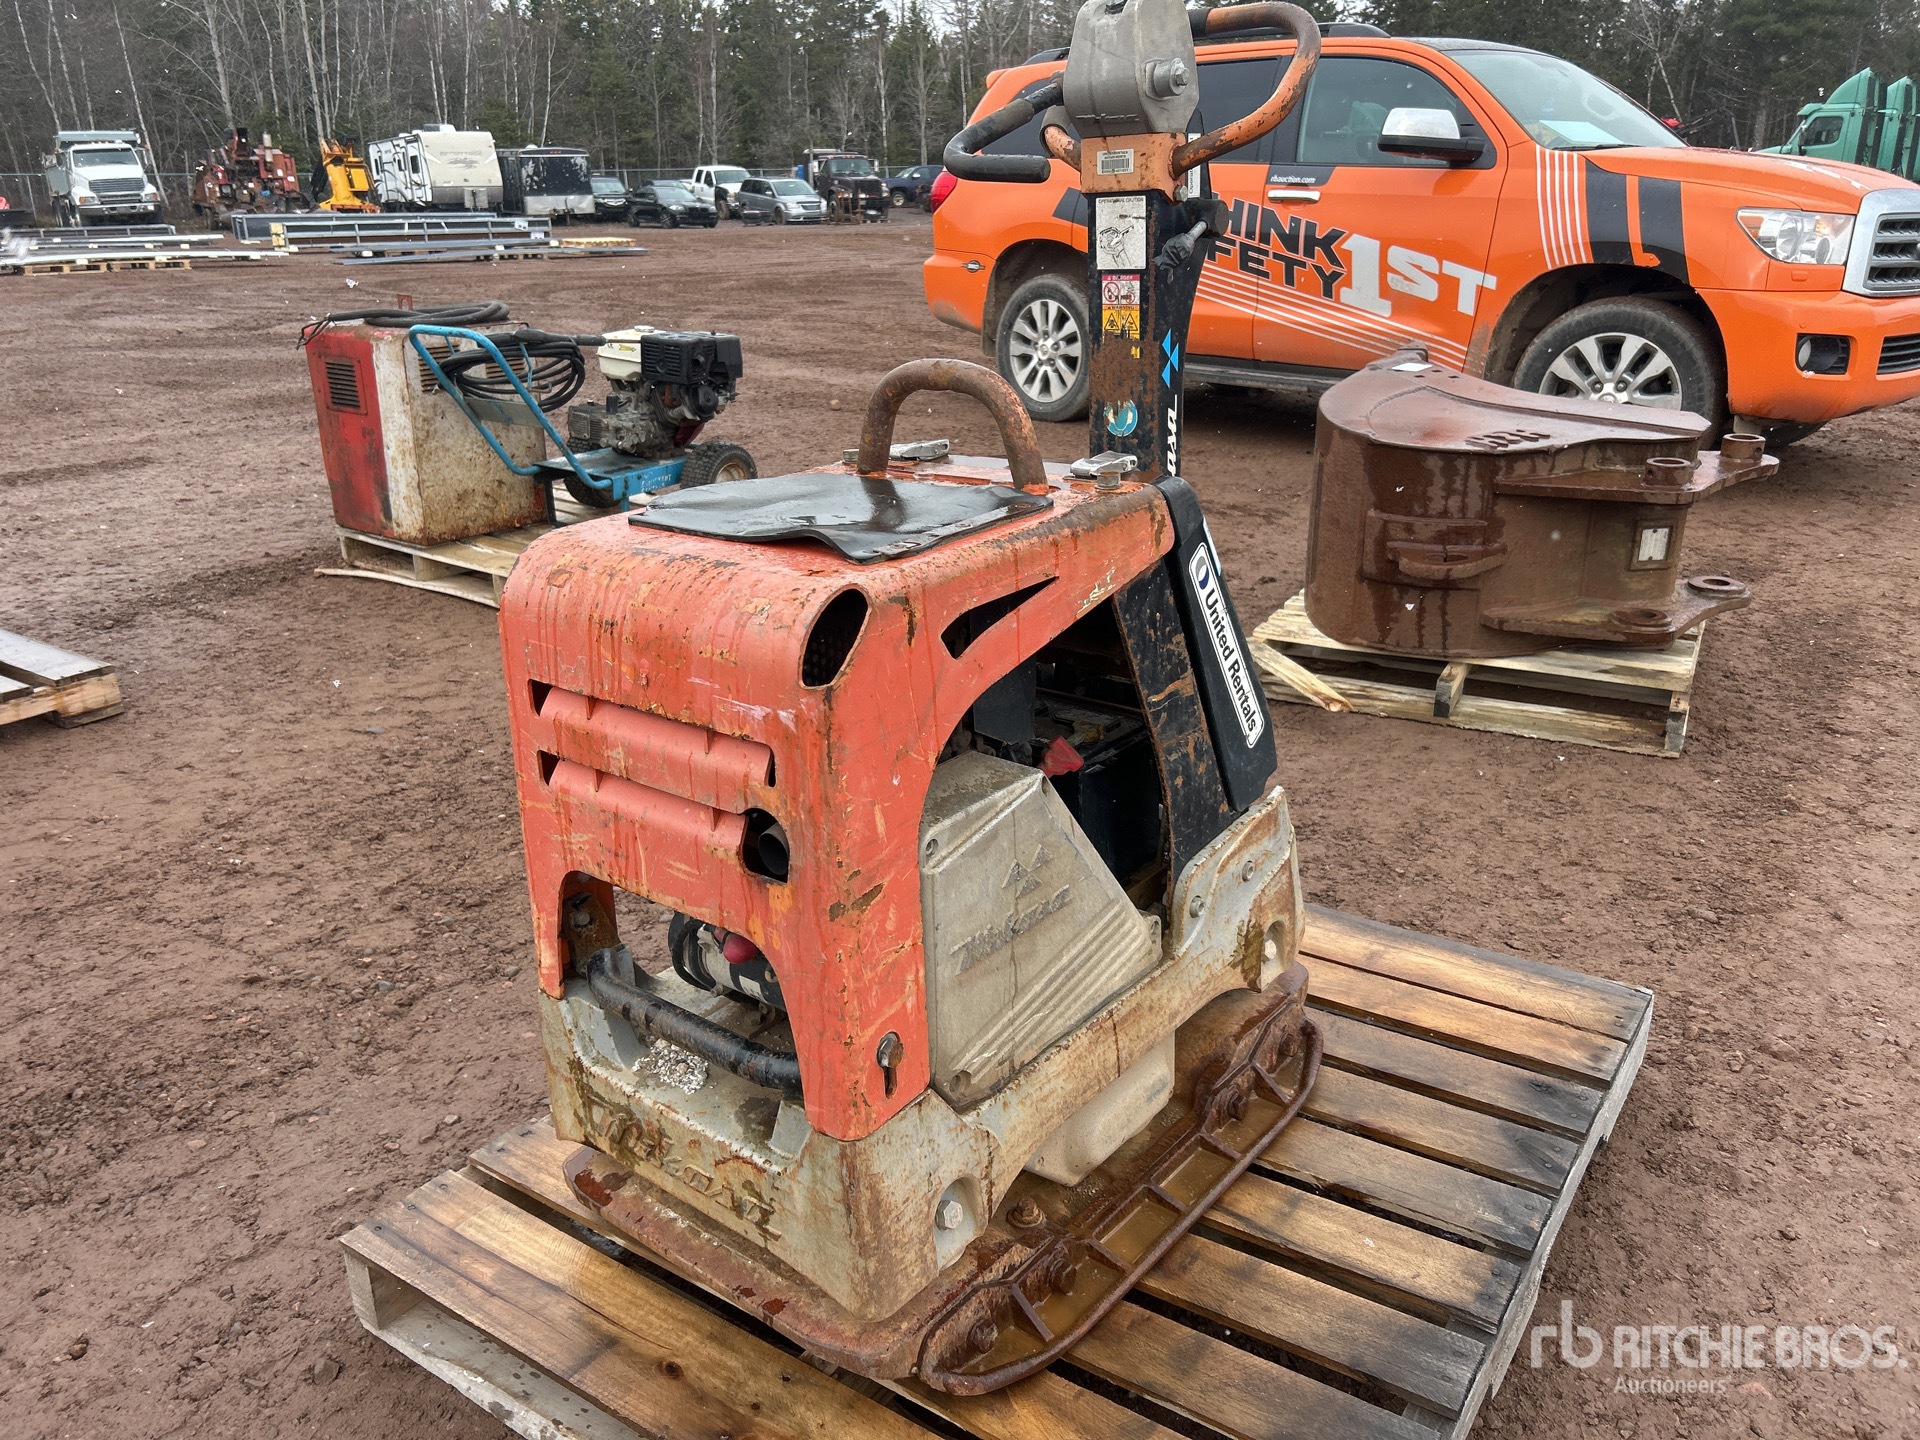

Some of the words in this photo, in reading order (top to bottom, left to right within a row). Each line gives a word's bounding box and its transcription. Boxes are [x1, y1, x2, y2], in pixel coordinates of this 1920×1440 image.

[1206, 236, 1344, 301] FETY
[1212, 191, 1348, 270] HINK
[1340, 233, 1497, 318] 1ST
[1205, 588, 1236, 661] United
[1227, 661, 1257, 733] Rentals
